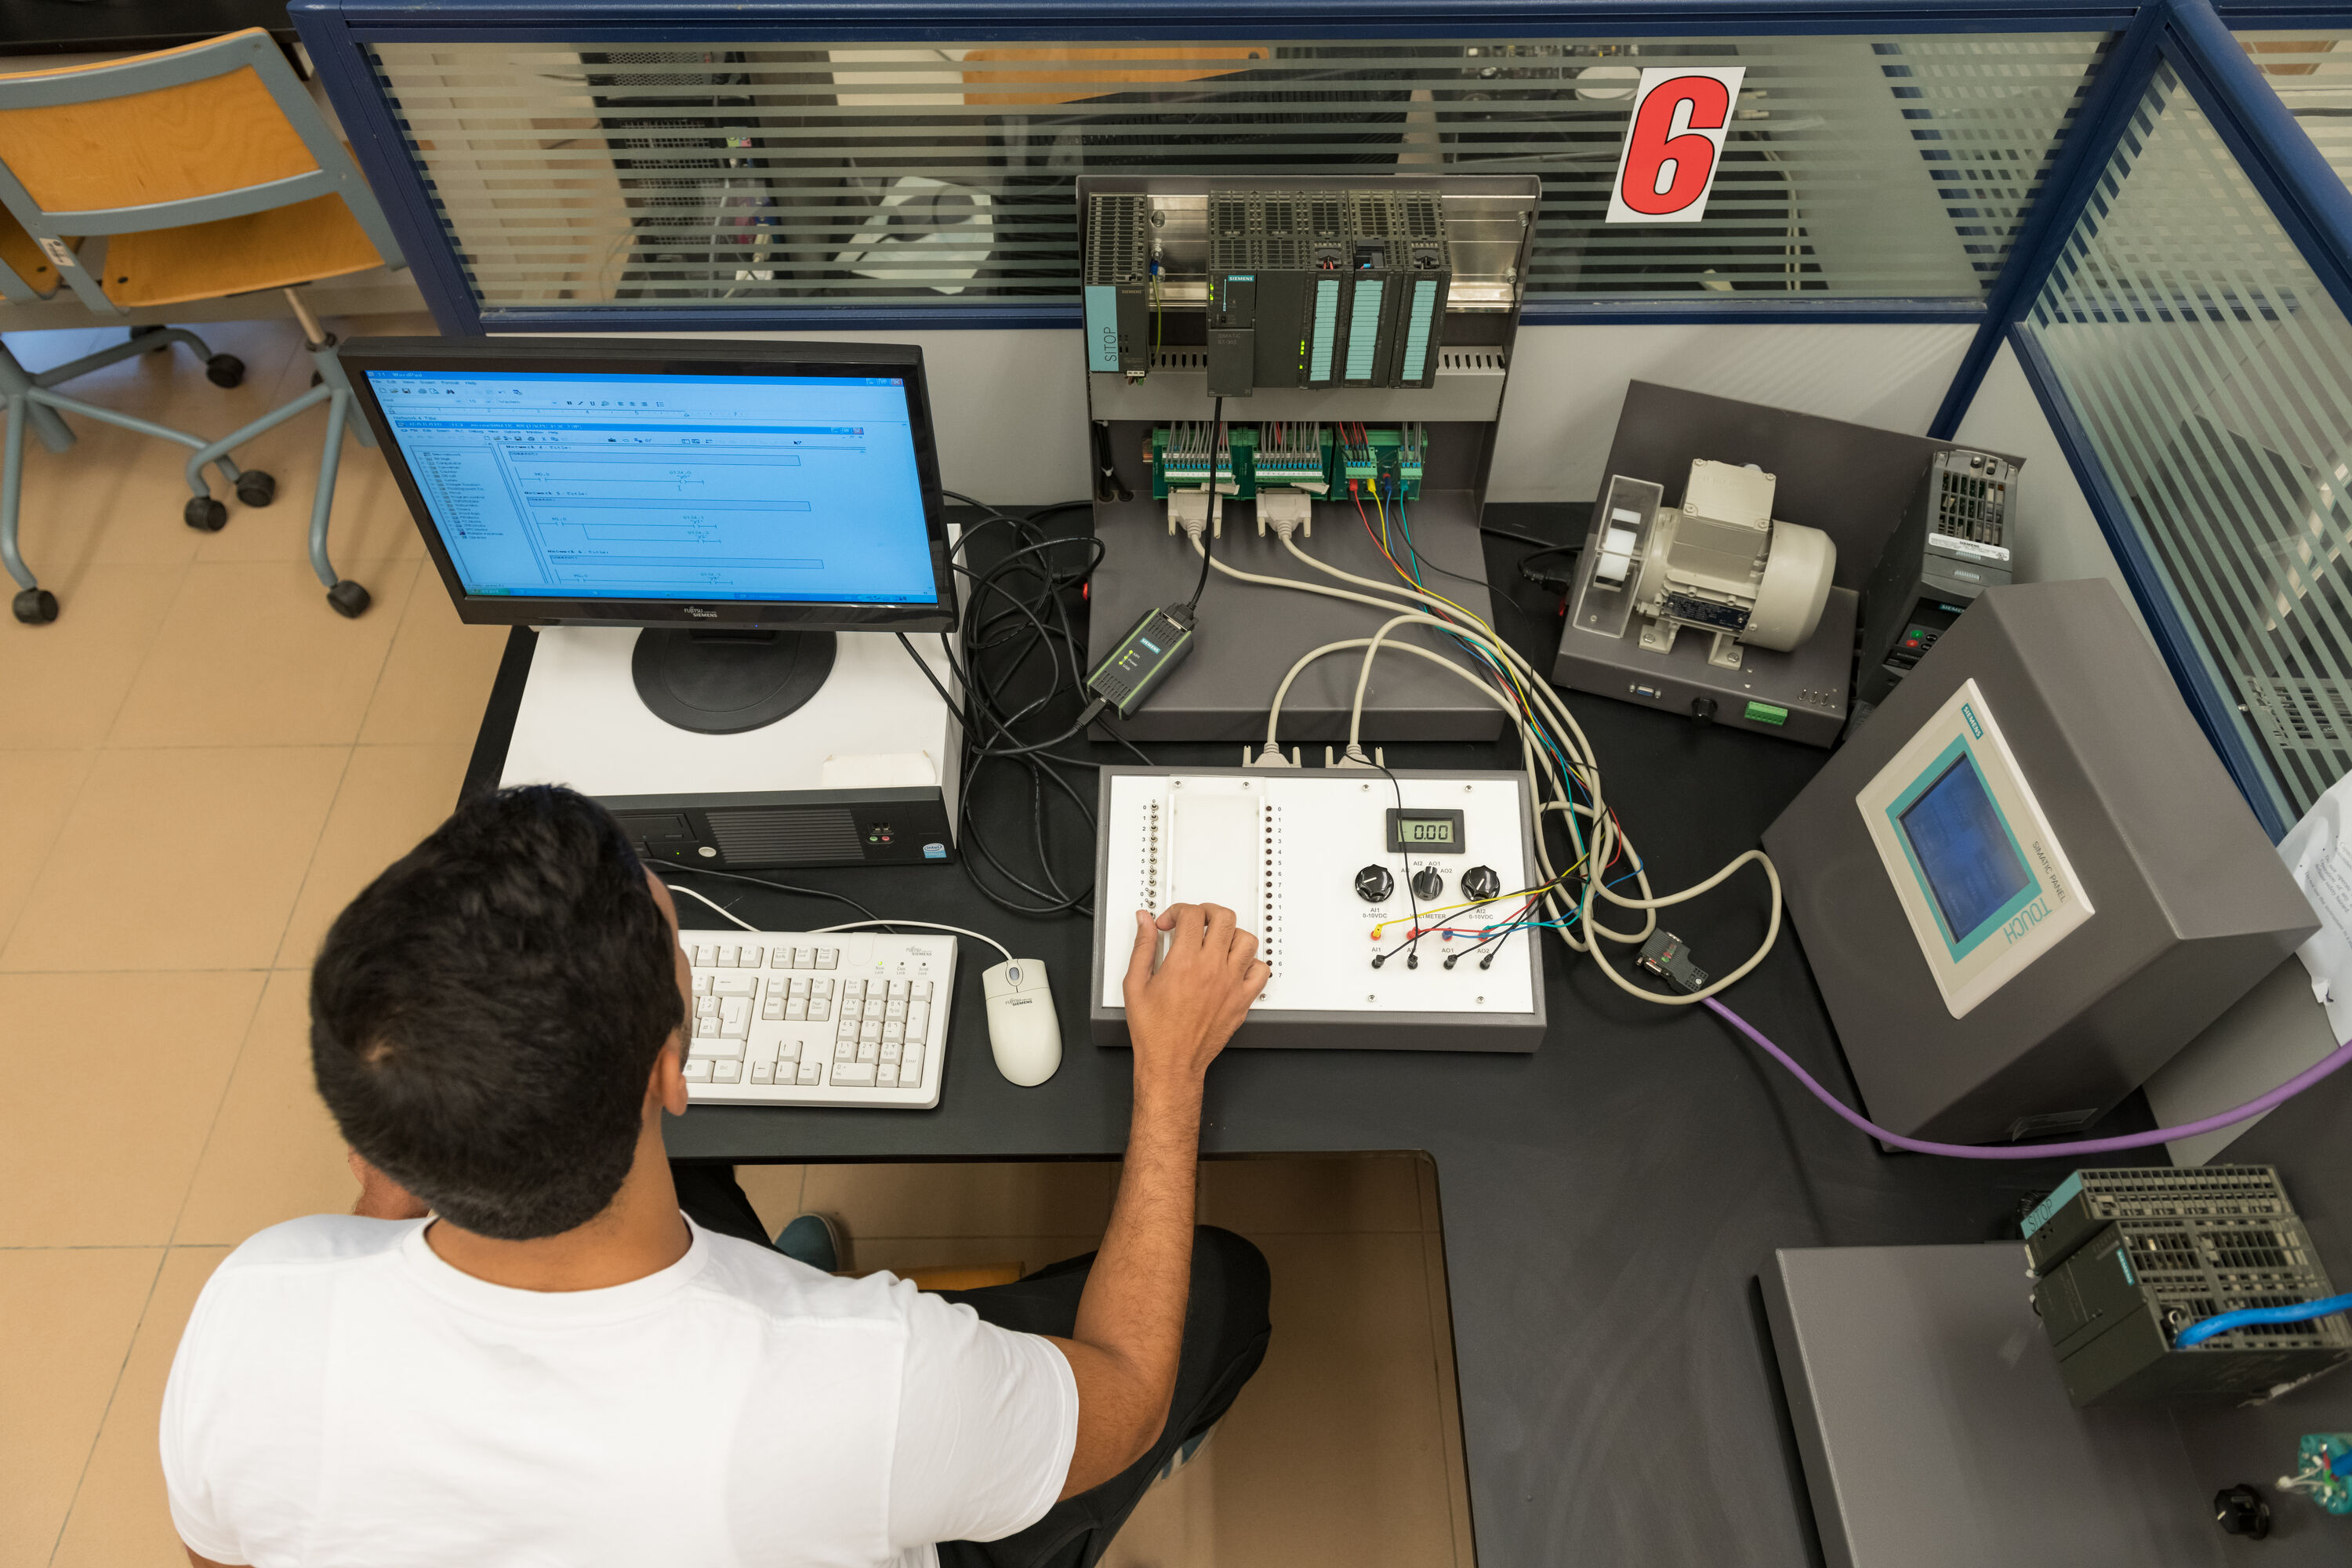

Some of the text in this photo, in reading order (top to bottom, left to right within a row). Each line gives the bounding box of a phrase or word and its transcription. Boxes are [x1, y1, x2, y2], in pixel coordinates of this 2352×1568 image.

[1621, 75, 1730, 215] 6
[1103, 327, 1117, 362] SITOP
[1128, 658, 1138, 666] Power
[1142, 639, 1159, 652] SIEMENS
[1963, 706, 1981, 738] SIEMENS
[1414, 824, 1448, 840] 0.00
[2032, 840, 2067, 903] SIMATIC PANEL
[2003, 897, 2053, 944] TOUCH
[2028, 1198, 2052, 1232] SITOP
[2118, 1249, 2132, 1284] SIEMENS
